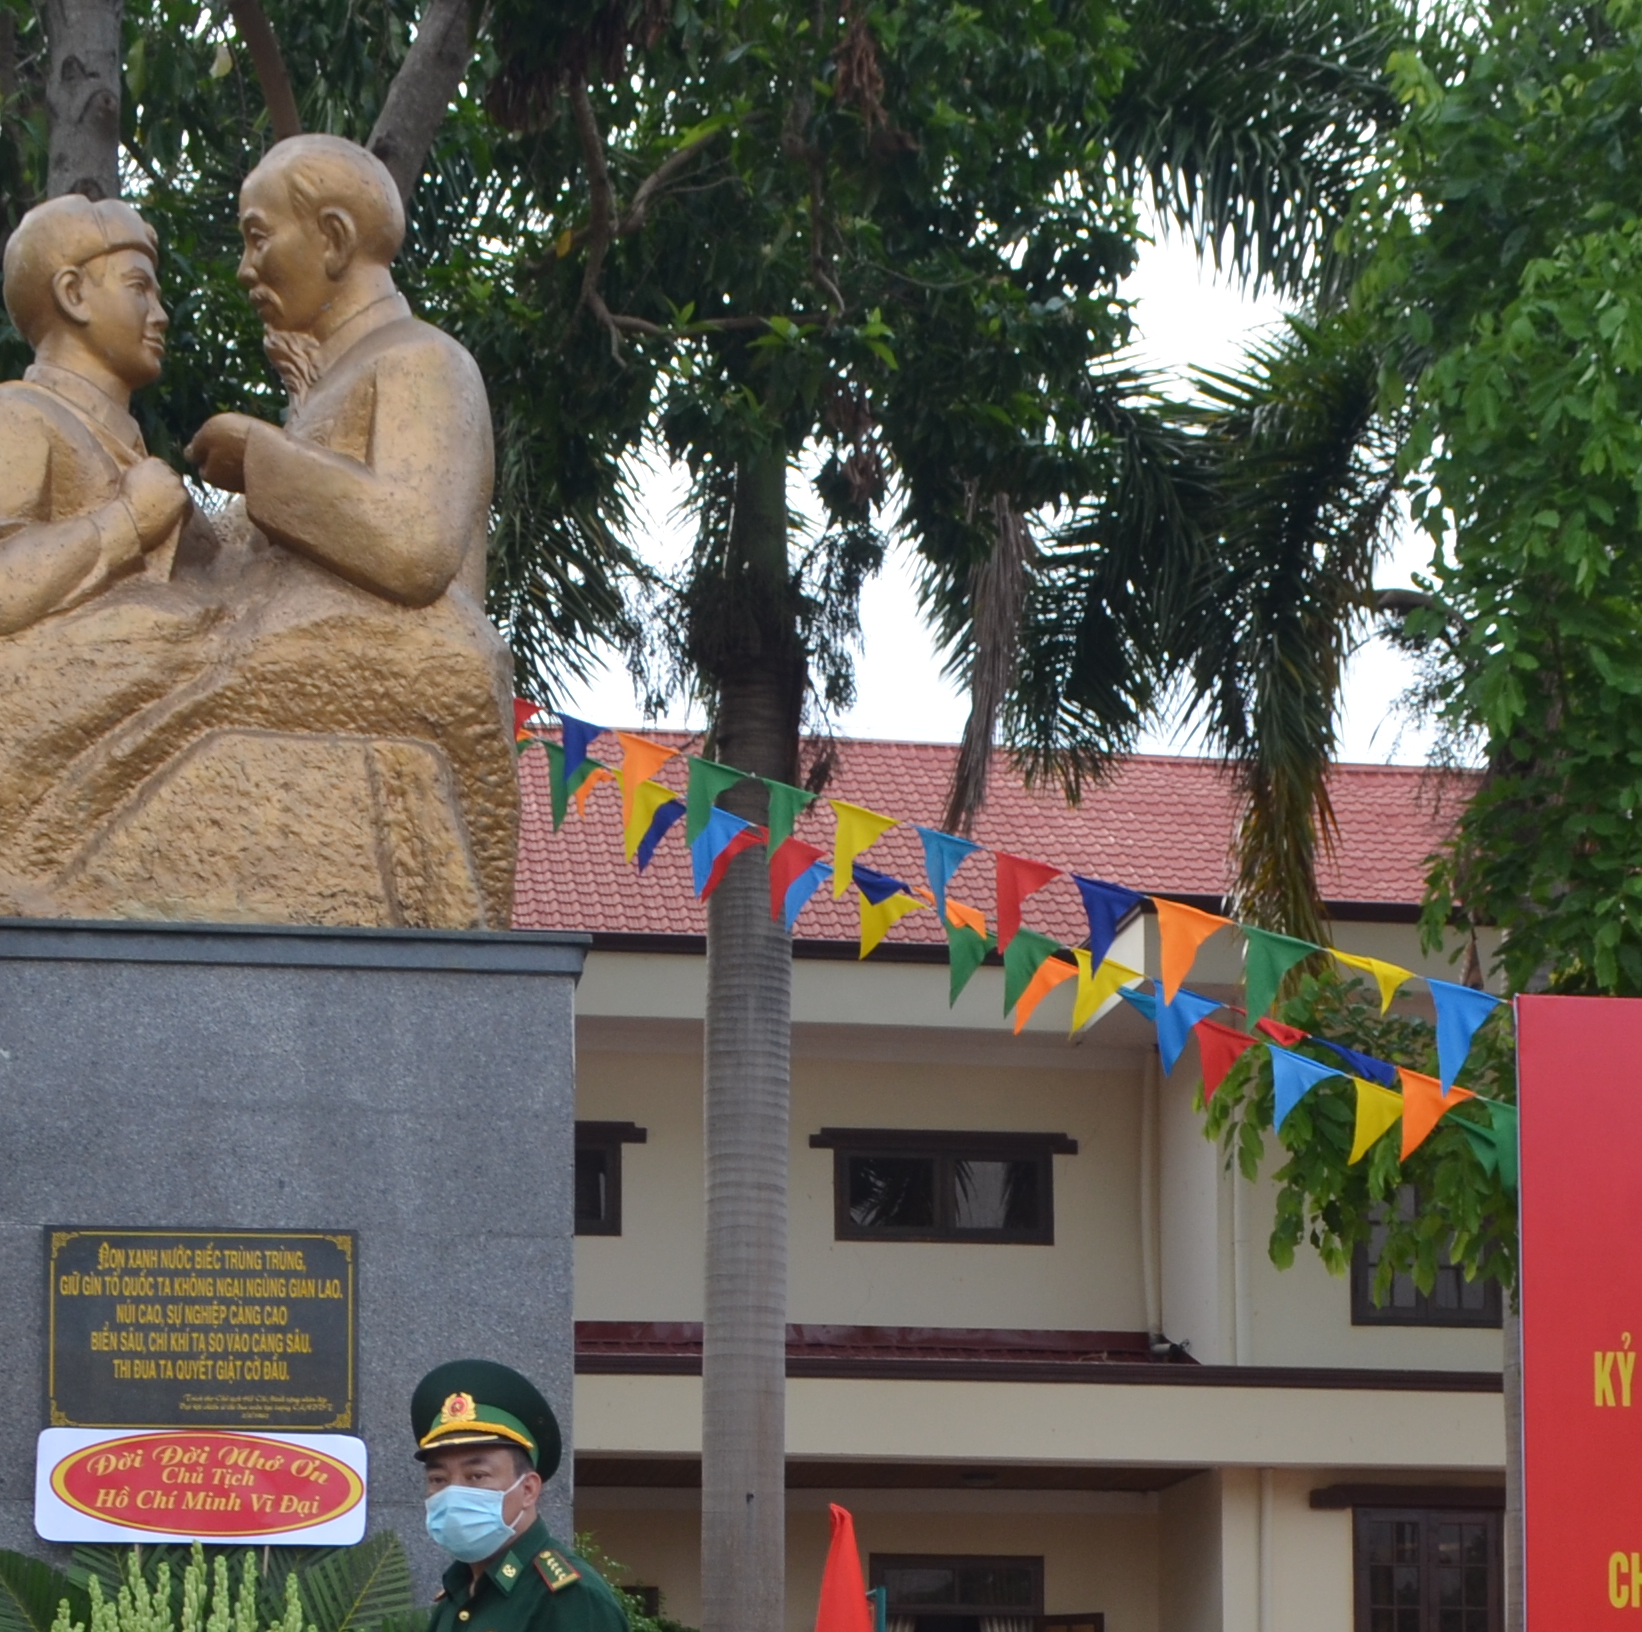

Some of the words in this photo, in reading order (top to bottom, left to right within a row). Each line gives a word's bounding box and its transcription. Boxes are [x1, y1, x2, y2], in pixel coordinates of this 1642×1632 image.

[127, 1249, 157, 1269] XANH
[195, 1243, 220, 1269] BIẾC
[82, 1272, 102, 1296] GÌN
[105, 1268, 120, 1296] TỔ
[123, 1270, 155, 1297] QUỐC
[157, 1277, 171, 1296] TA
[174, 1273, 214, 1297] KHÔNG
[217, 1278, 243, 1301] NGẠI
[289, 1279, 315, 1298] GIAN
[116, 1299, 135, 1324] NÚI
[138, 1305, 165, 1326] CAO,
[167, 1305, 183, 1327] SỰ
[185, 1301, 226, 1328] NGHIỆP
[228, 1298, 262, 1324] CÀNG
[264, 1306, 287, 1325] CAO
[91, 1322, 117, 1351] BIỂN
[120, 1327, 147, 1354] SÂU,
[149, 1327, 168, 1352] CHÍ
[170, 1328, 189, 1352] KHÍ
[192, 1333, 206, 1352] TA
[209, 1333, 225, 1352] SO
[227, 1328, 249, 1352] VÀO
[252, 1328, 283, 1353] CÀNG
[113, 1359, 131, 1379] THI
[133, 1359, 157, 1379] ĐUA
[159, 1360, 175, 1379] TA
[177, 1353, 214, 1381] QUYẾT
[216, 1356, 242, 1384] GIẬT
[1593, 1332, 1637, 1407] KỶ
[86, 1449, 144, 1477] Đời
[152, 1445, 210, 1467] Đời
[218, 1445, 285, 1472] Nhớ
[290, 1458, 330, 1485] Ơn
[161, 1466, 204, 1484] Chủ
[211, 1468, 256, 1489] Tịch
[94, 1487, 131, 1509] Hồ
[135, 1490, 177, 1509] Chí
[181, 1492, 242, 1511] Minh
[250, 1493, 274, 1513] Vĩ
[279, 1494, 321, 1518] Đại
